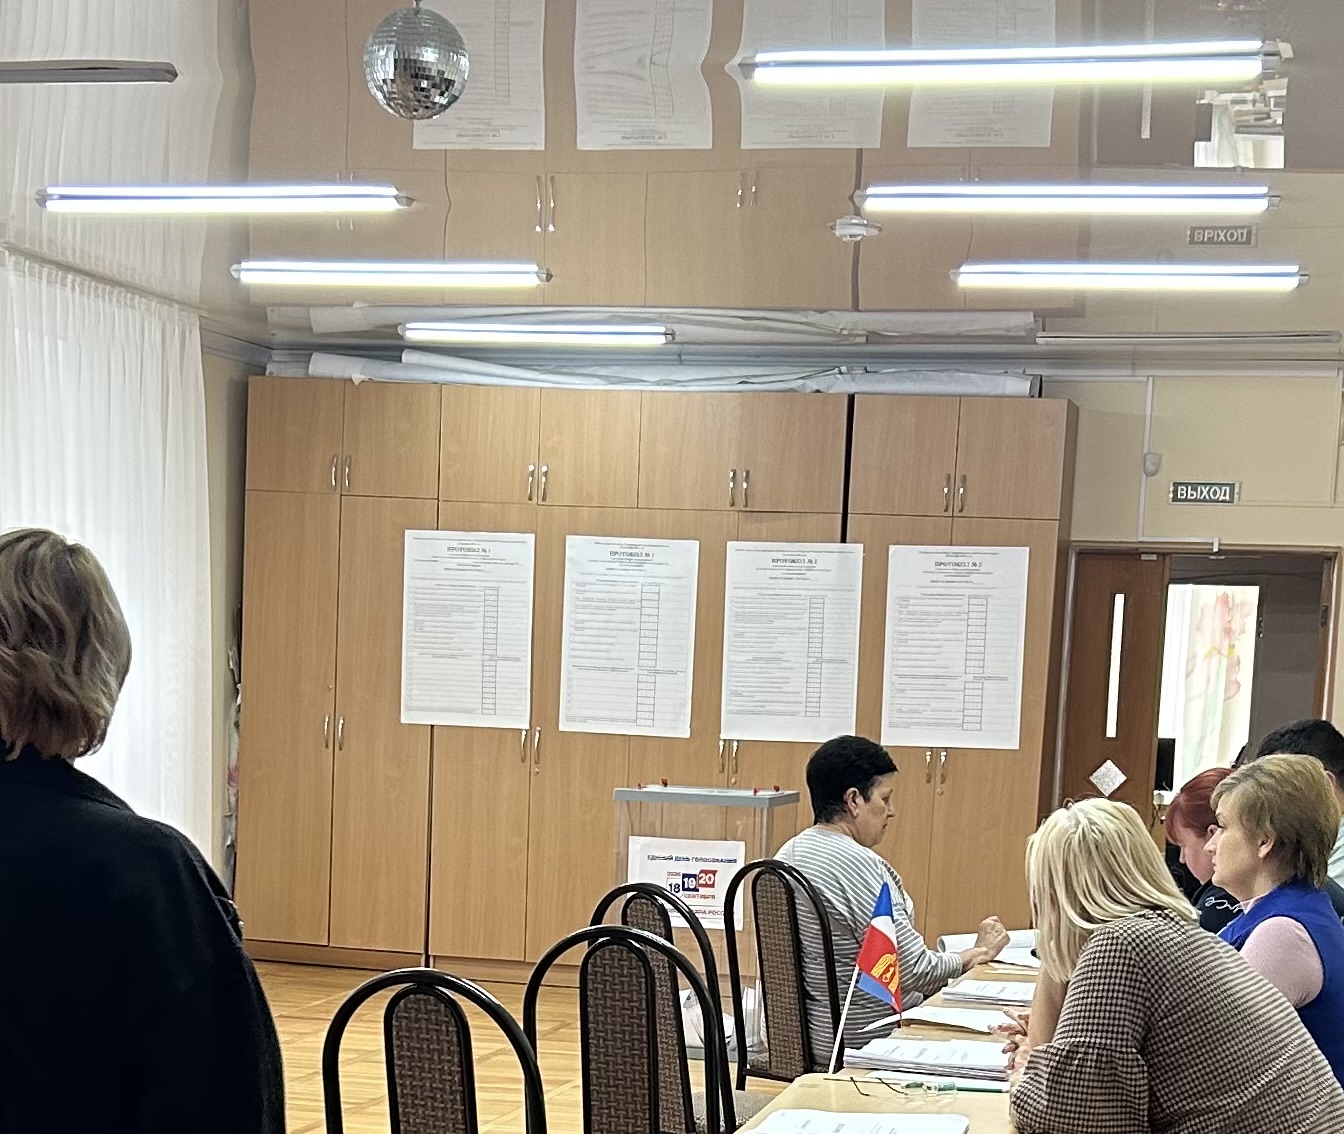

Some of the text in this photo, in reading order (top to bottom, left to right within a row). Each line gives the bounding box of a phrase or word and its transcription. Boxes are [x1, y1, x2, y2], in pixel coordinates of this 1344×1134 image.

[1177, 485, 1230, 501] ВЫХОД
[668, 873, 714, 893] 18 19 20
